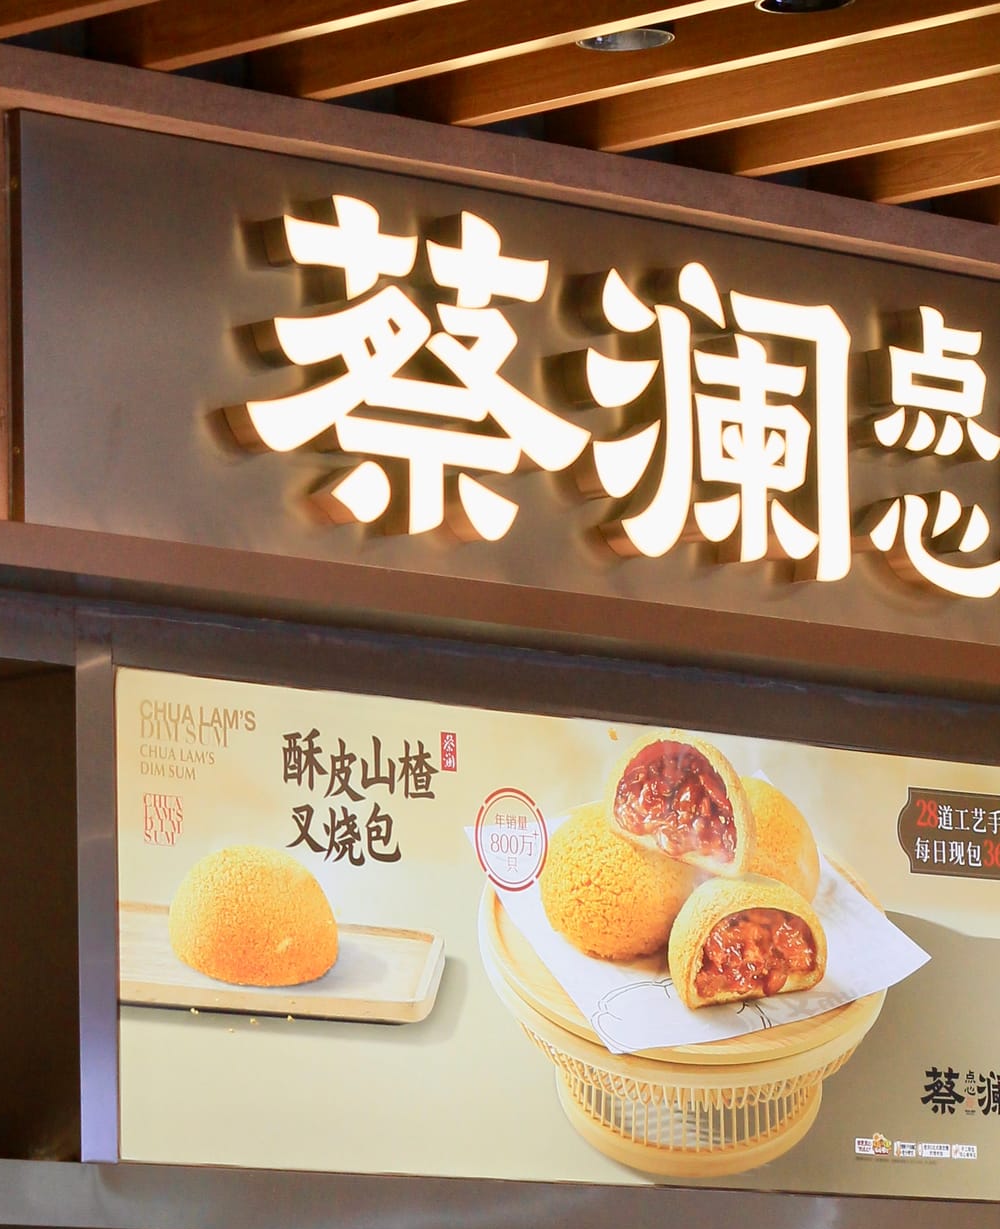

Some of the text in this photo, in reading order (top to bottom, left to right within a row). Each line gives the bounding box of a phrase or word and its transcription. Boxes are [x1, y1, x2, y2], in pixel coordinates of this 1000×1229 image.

[247, 194, 852, 583] 蔡澜
[872, 305, 1000, 599] 点心
[139, 699, 257, 732] CHUA LAM'S
[140, 719, 228, 748] DIM SUM
[139, 743, 215, 765] CHUA LAM'S
[140, 761, 196, 780] DIM SUM
[282, 728, 440, 803] 酥皮山楂
[495, 813, 528, 832] 年销量
[916, 799, 1000, 835] 28道工艺手
[286, 802, 402, 867] 叉烧包
[507, 856, 519, 873] 只
